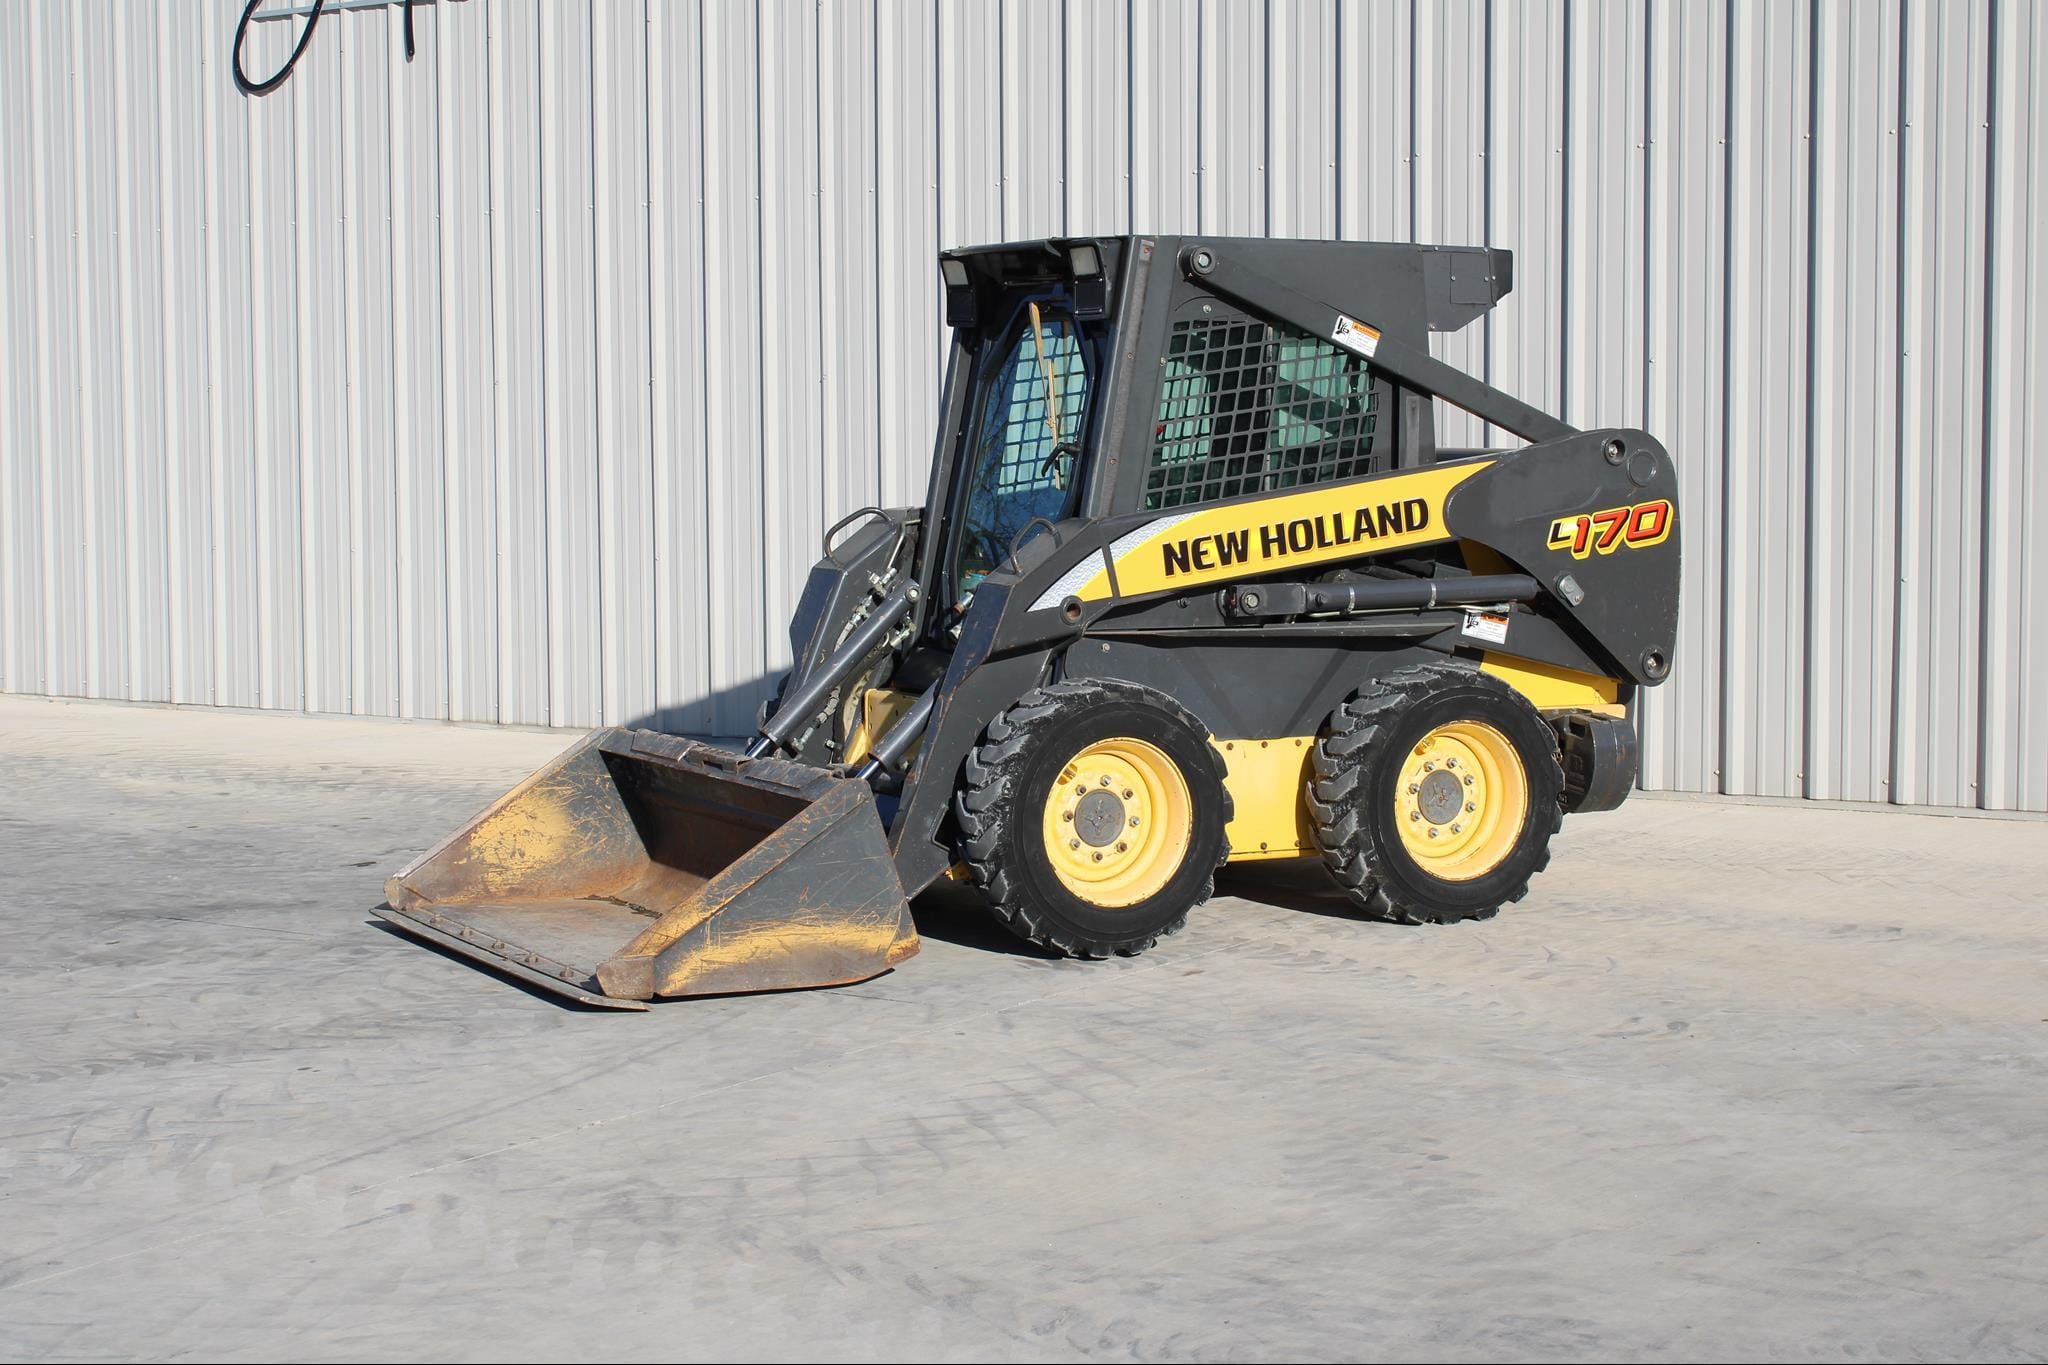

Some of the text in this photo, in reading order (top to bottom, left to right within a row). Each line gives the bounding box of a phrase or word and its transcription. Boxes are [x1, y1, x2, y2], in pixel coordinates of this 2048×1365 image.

[1162, 498, 1429, 577] NEW HOLLAND
[1548, 500, 1671, 558] L170
